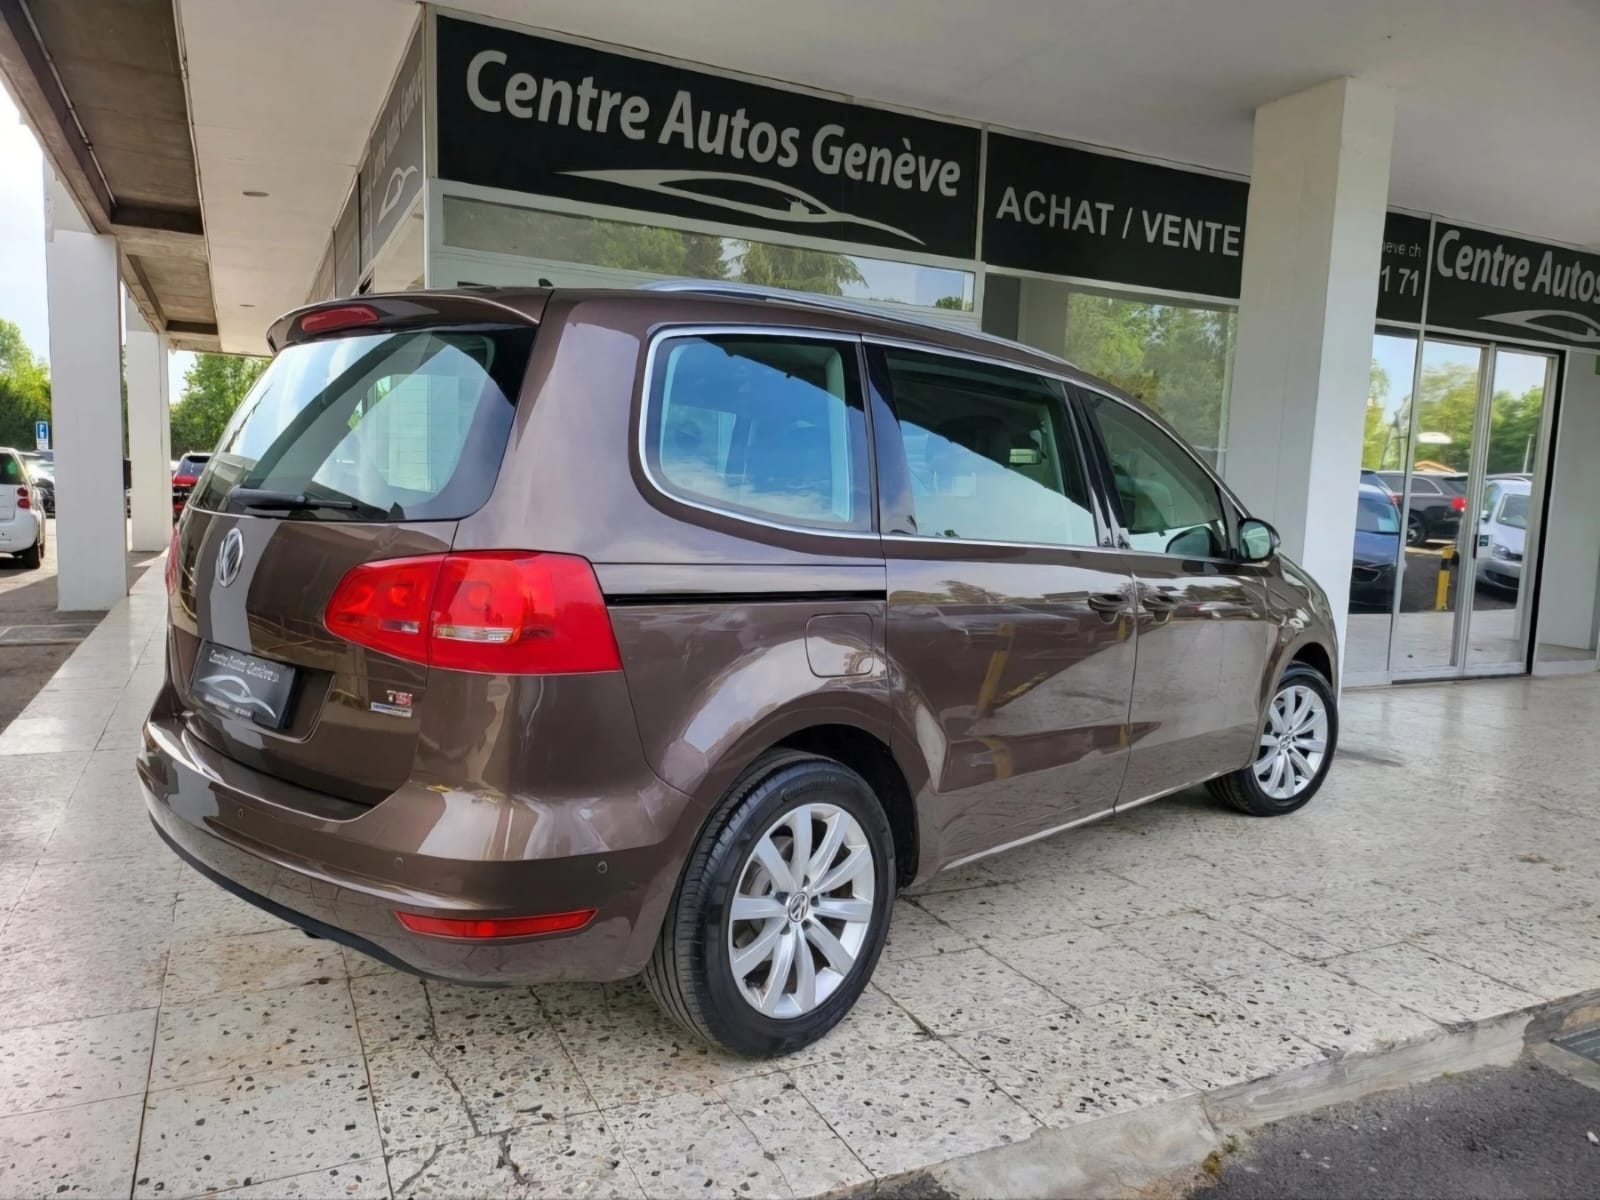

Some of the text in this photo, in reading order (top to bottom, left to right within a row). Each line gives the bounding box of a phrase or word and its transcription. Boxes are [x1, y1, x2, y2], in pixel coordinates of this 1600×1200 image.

[465, 49, 650, 141] Centre
[658, 90, 800, 168] Autos
[811, 124, 961, 197] Genève
[996, 186, 1241, 257] ACHAT / VENTE
[1398, 268, 1420, 297] 71
[1436, 229, 1530, 291] Centre
